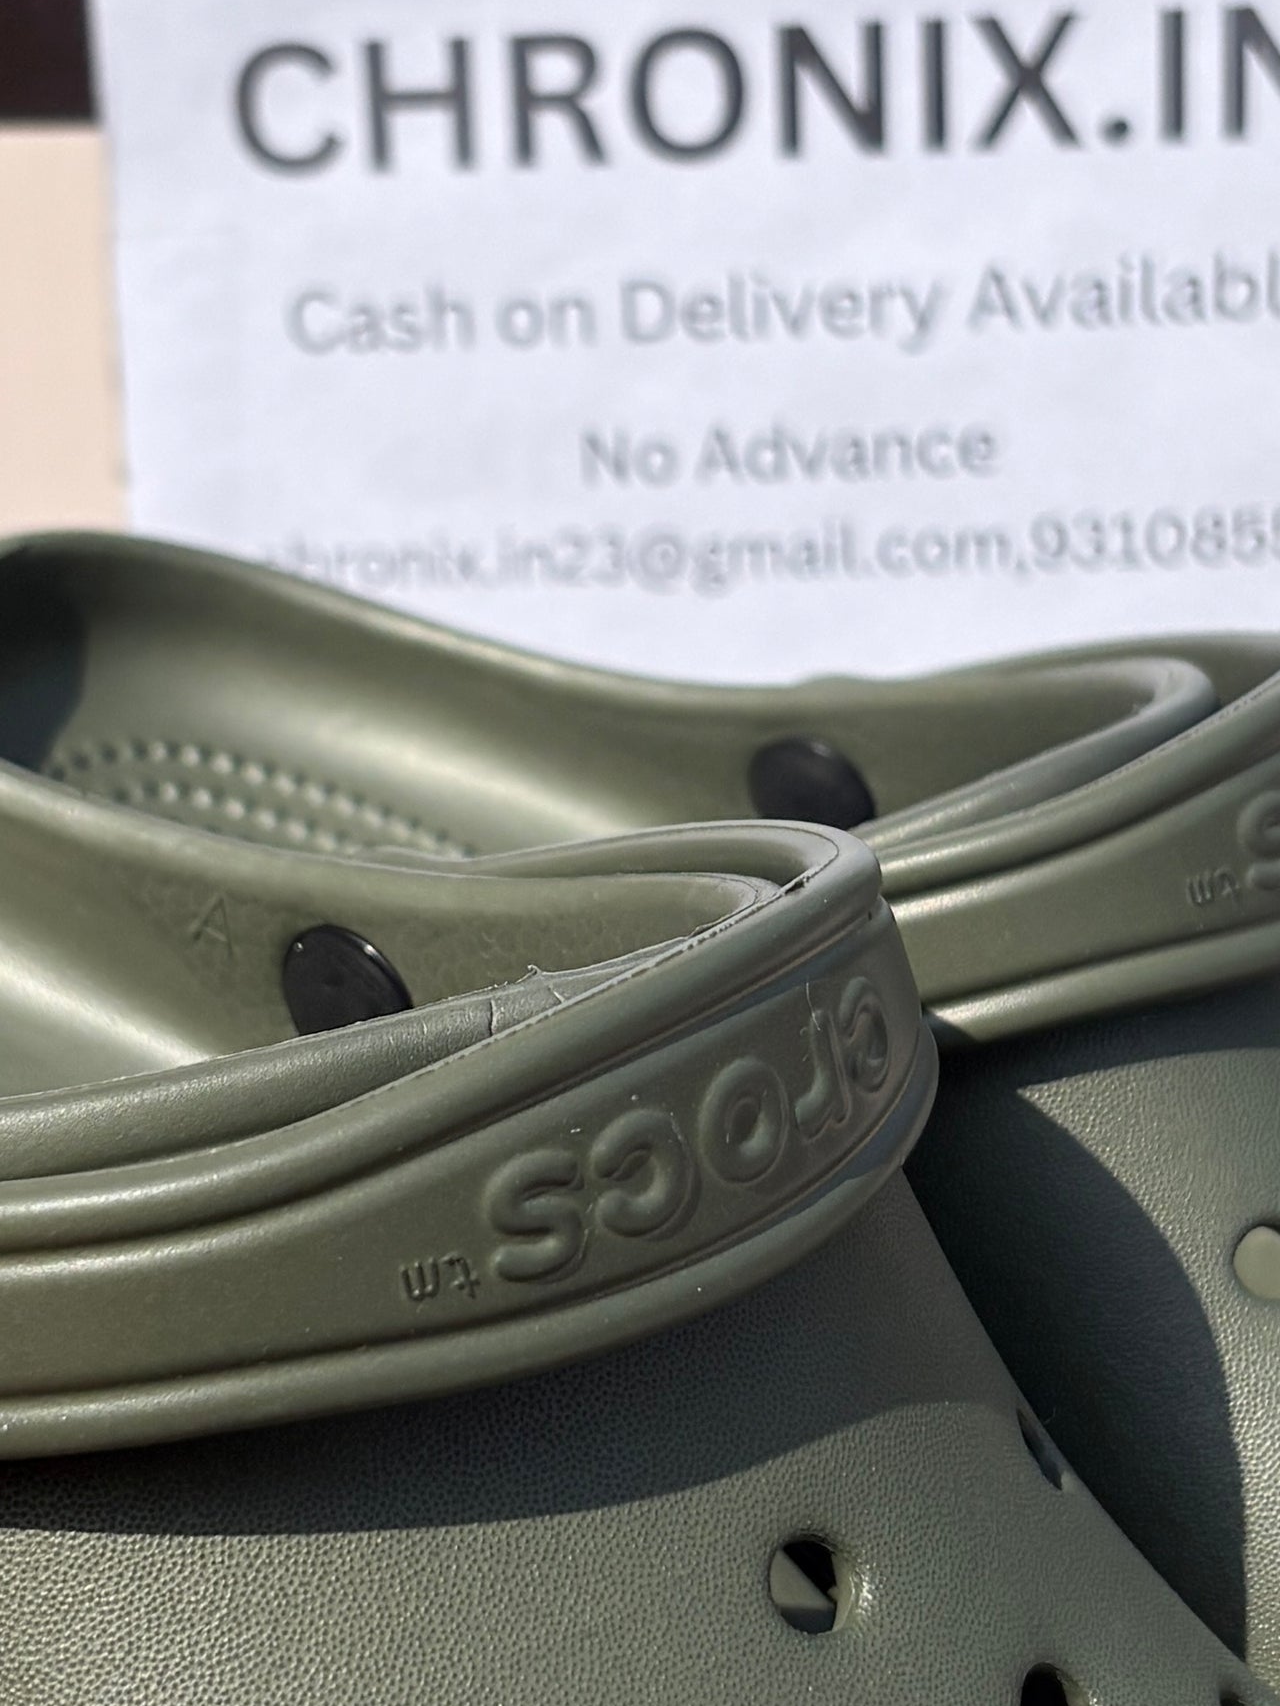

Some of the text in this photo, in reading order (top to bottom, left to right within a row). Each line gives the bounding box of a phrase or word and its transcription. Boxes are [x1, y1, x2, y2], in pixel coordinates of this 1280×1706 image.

[285, 281, 477, 356] Cash
[495, 293, 600, 351] on
[619, 267, 944, 356] Delivery
[578, 413, 1001, 488] No Advance
[483, 974, 893, 1284] crocs
